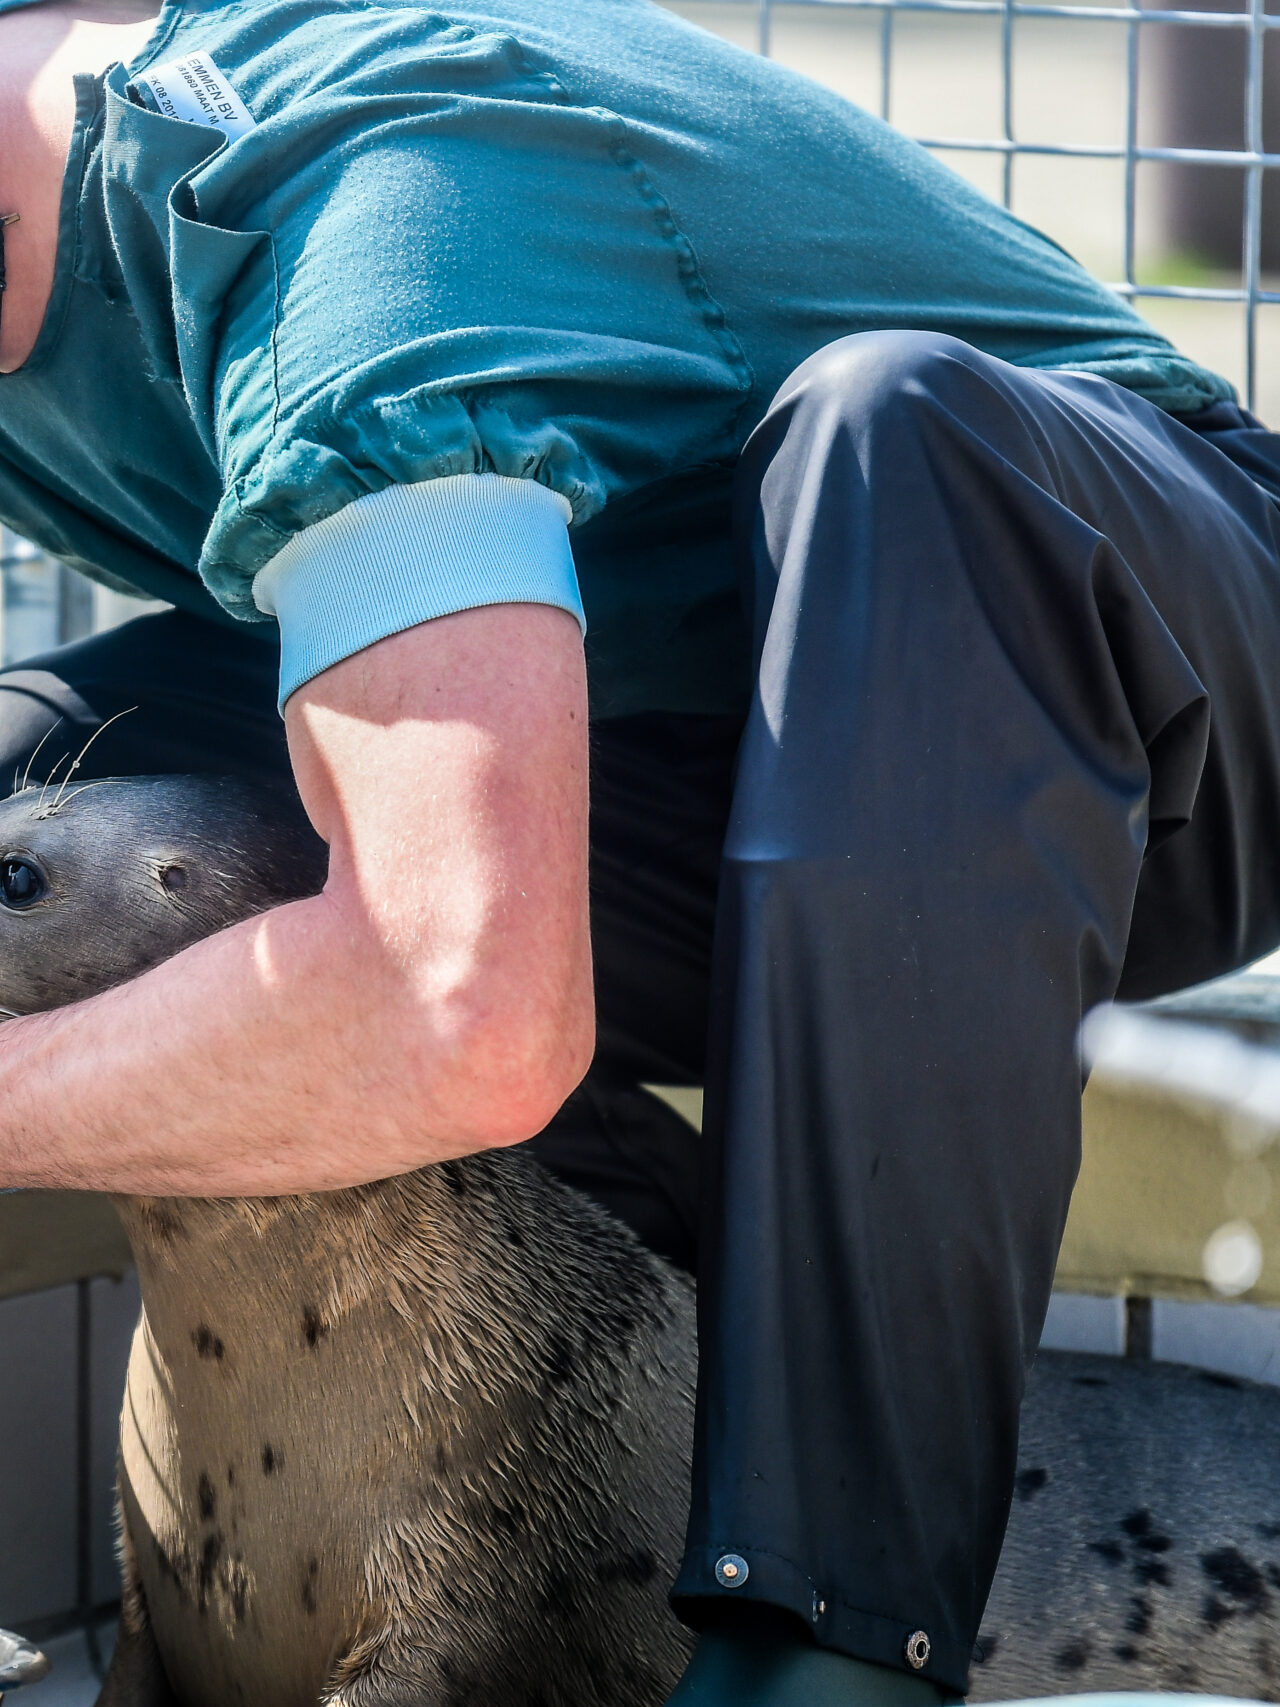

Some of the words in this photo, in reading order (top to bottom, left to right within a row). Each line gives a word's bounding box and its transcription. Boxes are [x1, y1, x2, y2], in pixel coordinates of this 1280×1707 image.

[155, 86, 167, 98] 08
[188, 58, 225, 101] EMMEN
[217, 102, 238, 120] BV
[194, 89, 214, 113] MAAT
[208, 115, 219, 125] M
